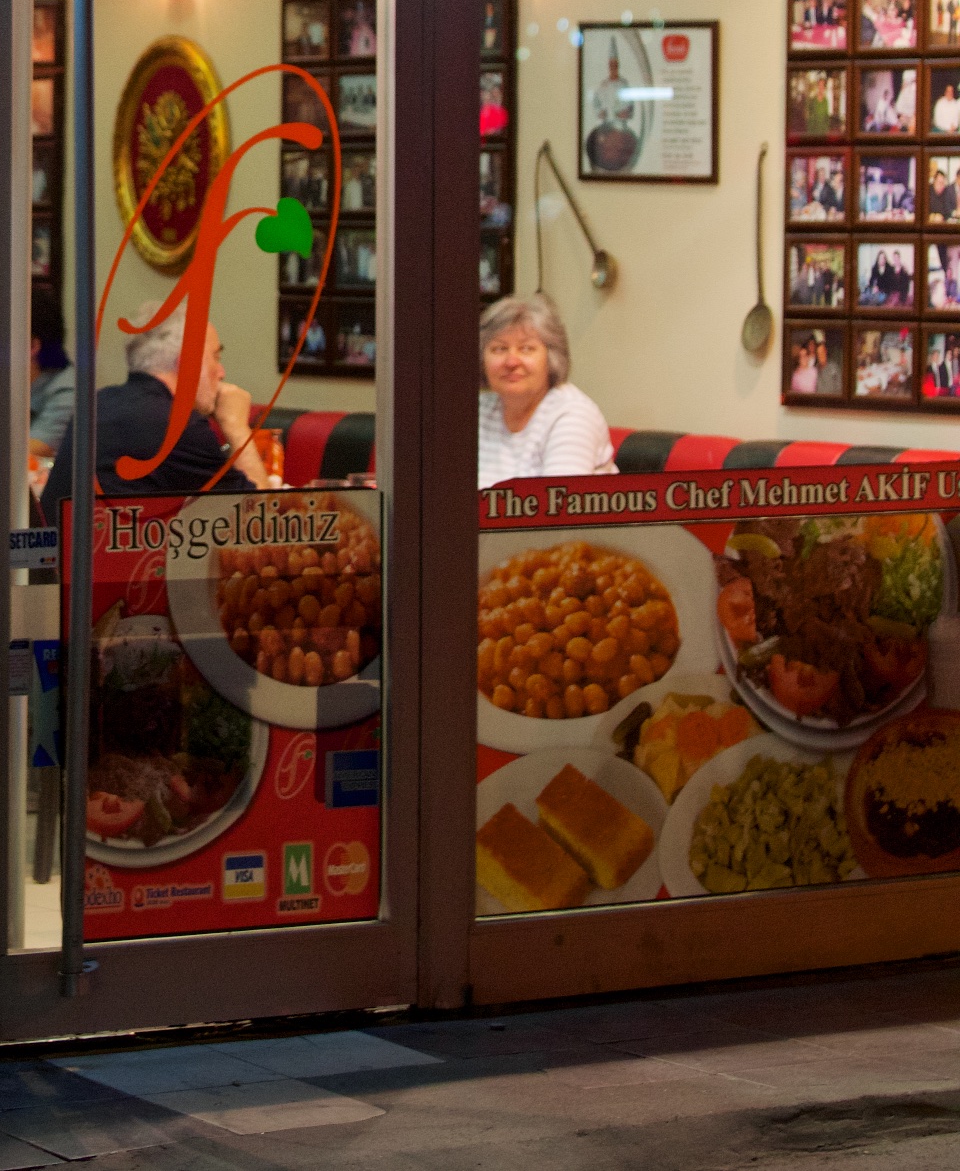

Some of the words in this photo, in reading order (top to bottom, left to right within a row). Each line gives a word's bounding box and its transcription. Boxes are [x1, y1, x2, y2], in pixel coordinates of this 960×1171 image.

[483, 487, 539, 519] The
[546, 486, 657, 516] Famous
[665, 480, 733, 511] Chef
[740, 477, 849, 508] Mehmet
[854, 466, 931, 502] AKİF
[936, 470, 960, 500] U
[10, 531, 57, 549] SETCARD
[105, 500, 340, 560] Hoşgeldiniz
[235, 871, 254, 883] VISA
